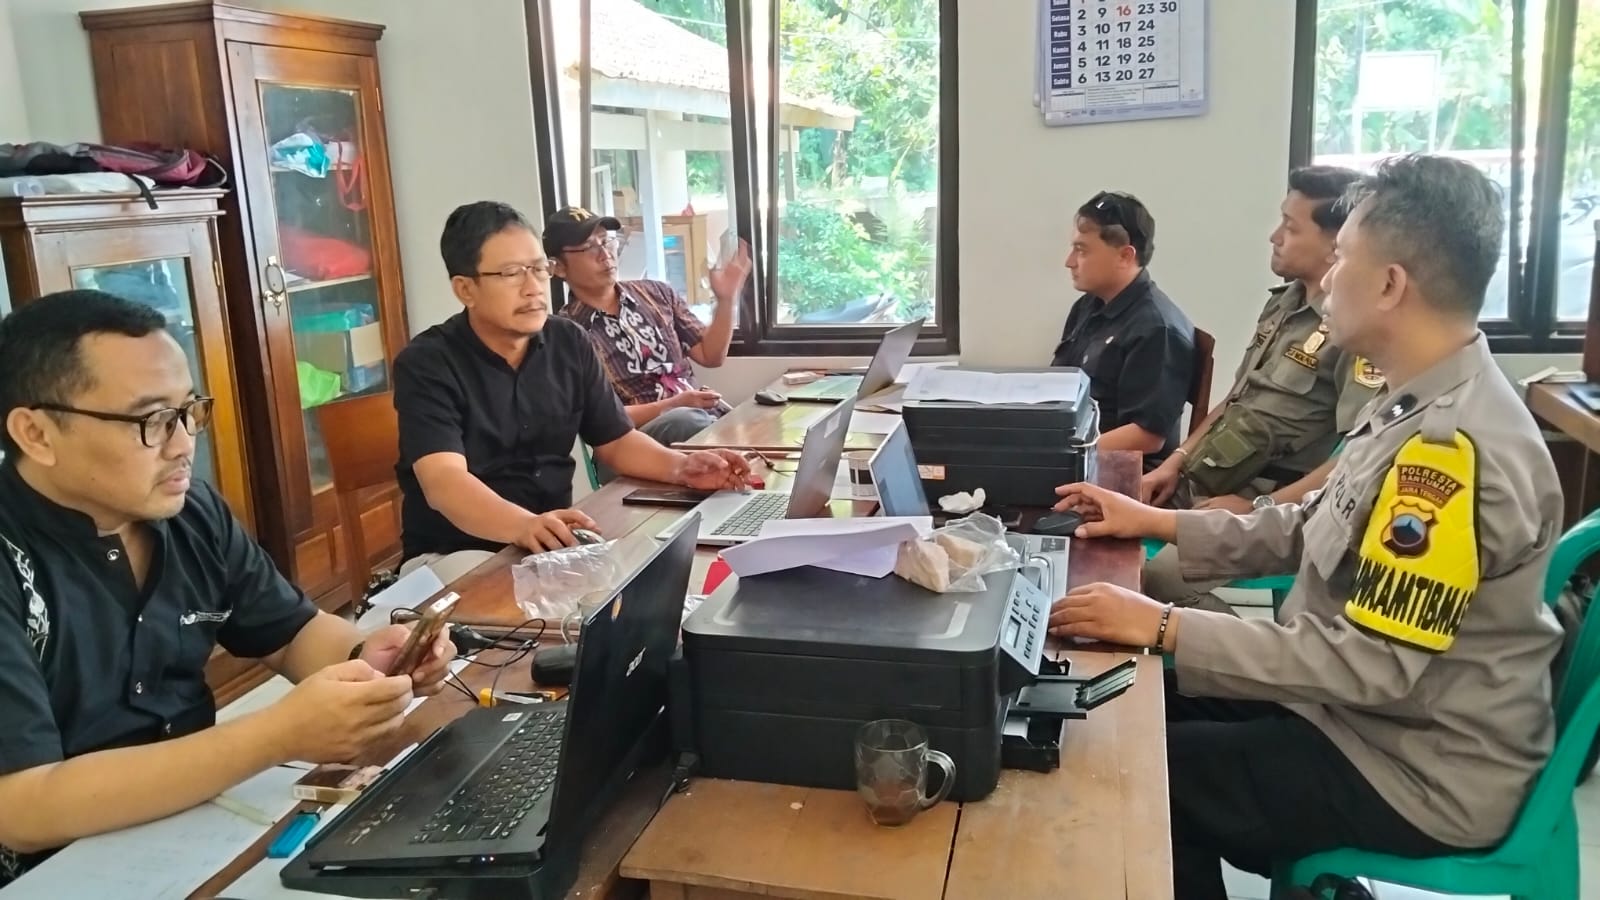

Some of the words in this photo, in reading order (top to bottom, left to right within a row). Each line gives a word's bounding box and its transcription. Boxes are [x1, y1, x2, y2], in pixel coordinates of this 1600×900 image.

[1077, 8, 1086, 20] 2
[1097, 7, 1107, 18] 9
[1116, 4, 1131, 16] 16
[1137, 3, 1155, 15] 23
[1159, 1, 1177, 13] 30
[1077, 25, 1086, 36] 3
[1094, 23, 1110, 35] 10
[1116, 21, 1131, 32] 17
[1137, 19, 1155, 31] 24
[1077, 41, 1087, 52] 4
[1095, 39, 1109, 51] 11
[1116, 37, 1131, 49] 18
[1137, 35, 1155, 47] 25
[1077, 57, 1086, 69] 5
[1095, 55, 1111, 67] 12
[1116, 53, 1131, 65] 19
[1138, 51, 1155, 64] 26
[1077, 73, 1087, 84] 6
[1095, 71, 1111, 83] 13
[1115, 69, 1133, 81] 20
[1138, 68, 1155, 80] 27
[1400, 466, 1457, 491] POLRESTA
[1400, 474, 1452, 496] BANYUMAS
